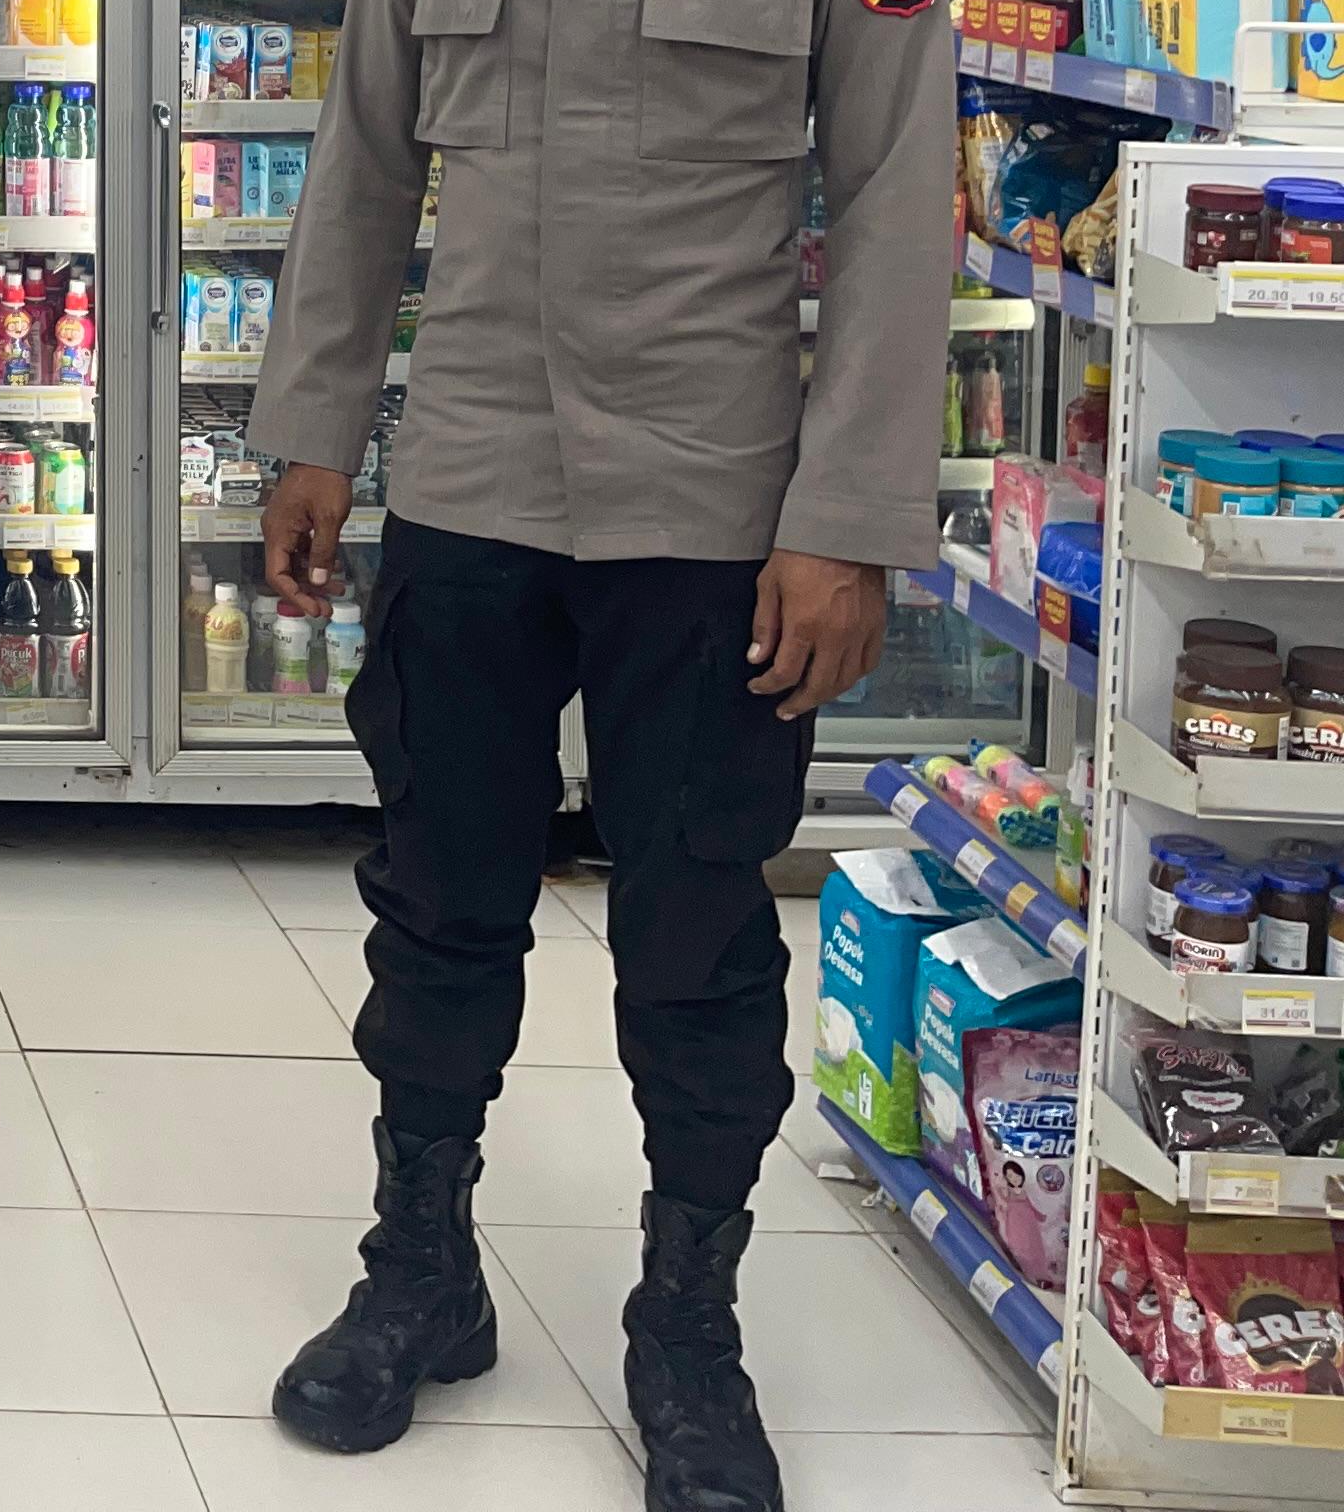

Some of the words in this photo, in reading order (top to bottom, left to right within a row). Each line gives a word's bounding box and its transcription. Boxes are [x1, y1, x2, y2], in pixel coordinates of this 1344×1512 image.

[1030, 7, 1051, 20] SUPER
[272, 161, 302, 169] ULTRA
[276, 168, 297, 176] MILK
[1185, 718, 1257, 743] CERES
[833, 925, 864, 963] Popok
[1184, 943, 1221, 959] MORIN
[824, 942, 863, 986] Dewasa
[1215, 1312, 1344, 1356] CERES
